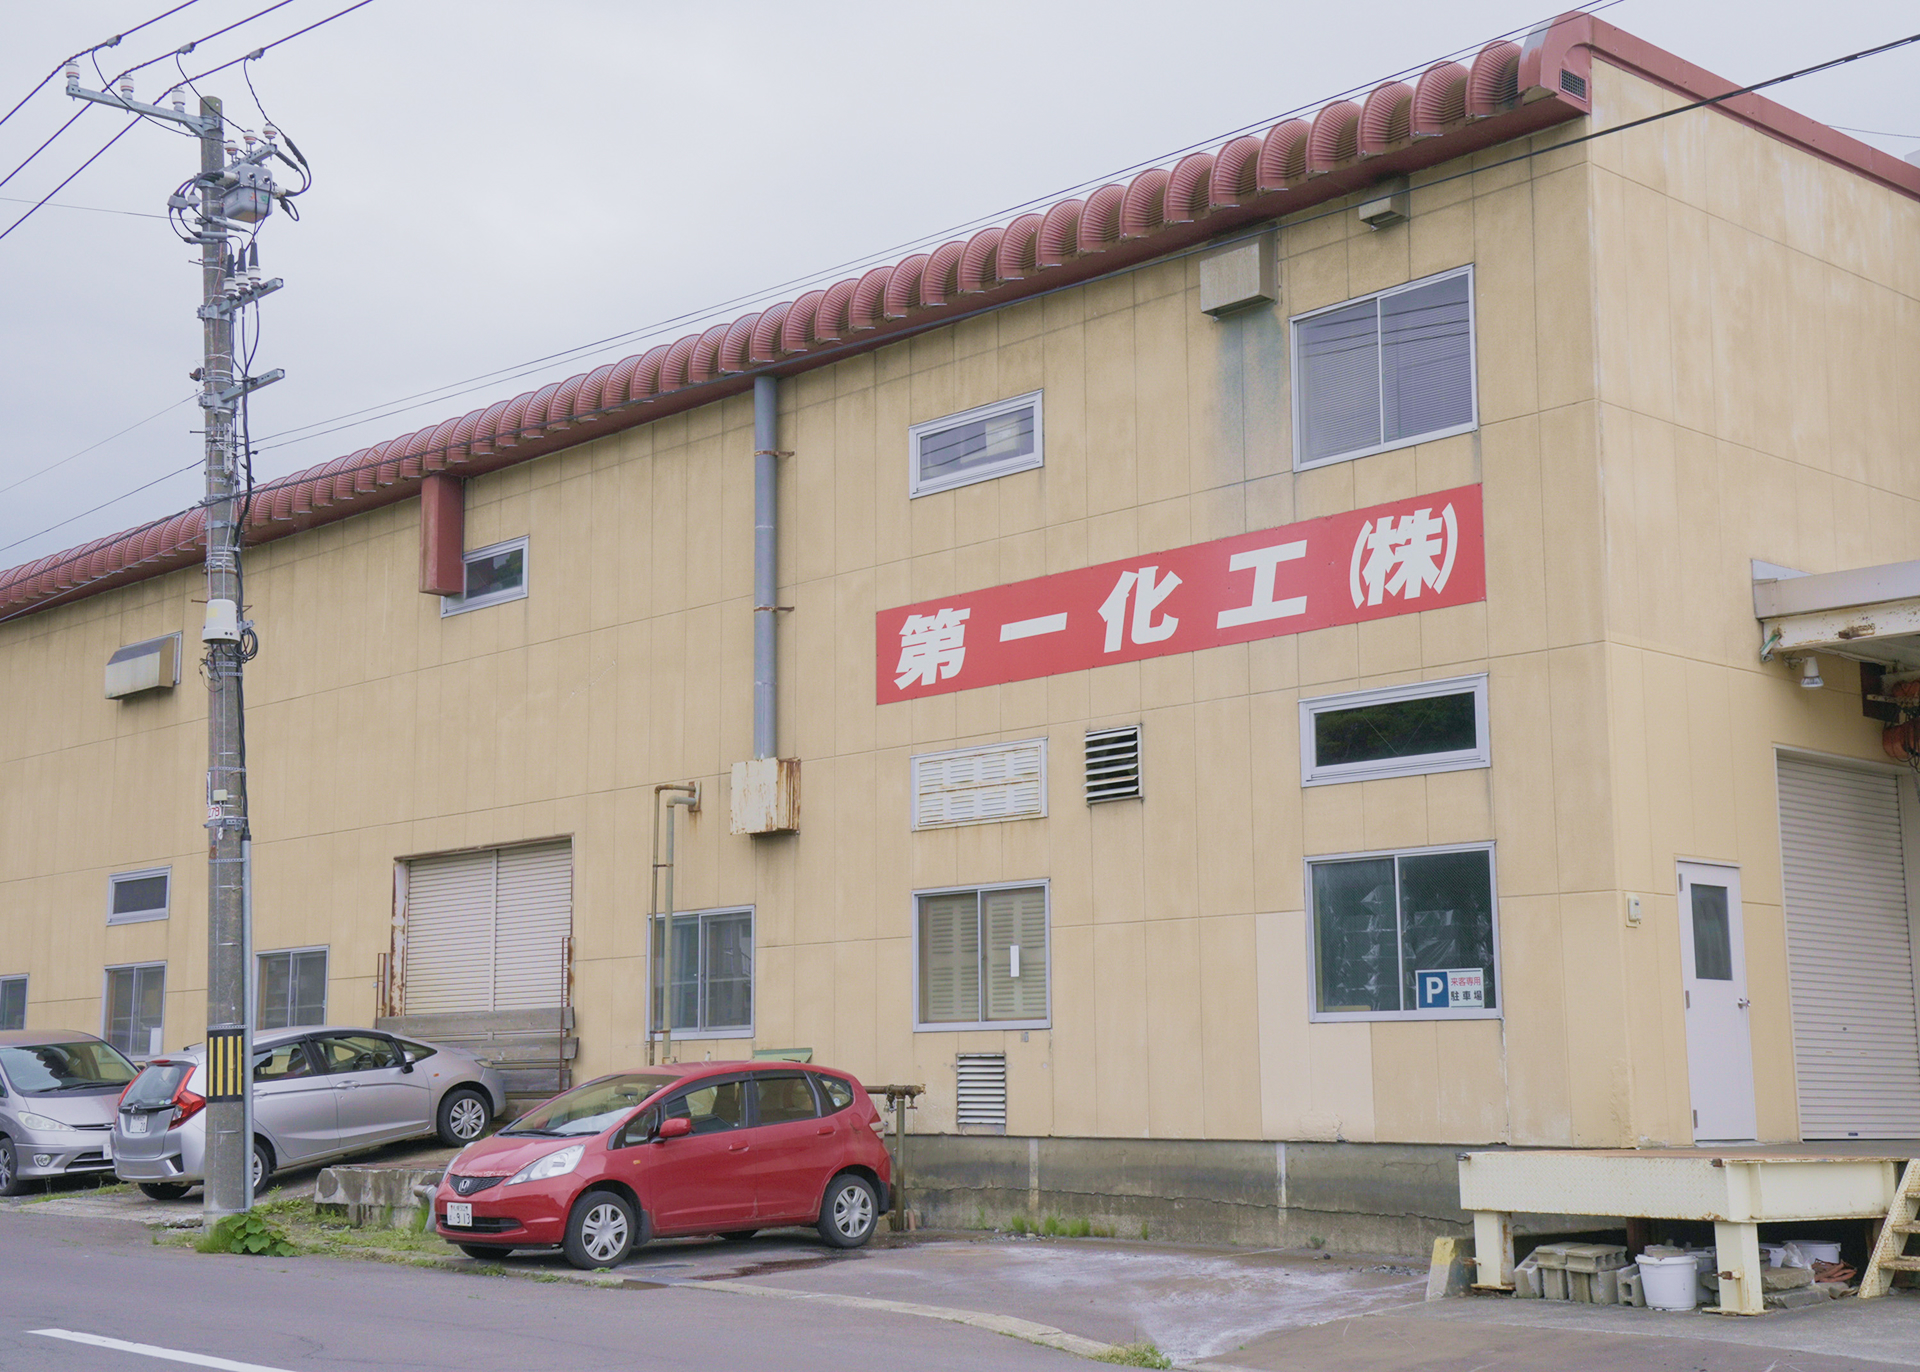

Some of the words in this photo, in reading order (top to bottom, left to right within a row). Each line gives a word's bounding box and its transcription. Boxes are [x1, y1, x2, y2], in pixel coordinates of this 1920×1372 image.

[1450, 976, 1482, 987] 来客専用
[1426, 976, 1444, 1004] P
[1450, 990, 1483, 1001] 駐車場
